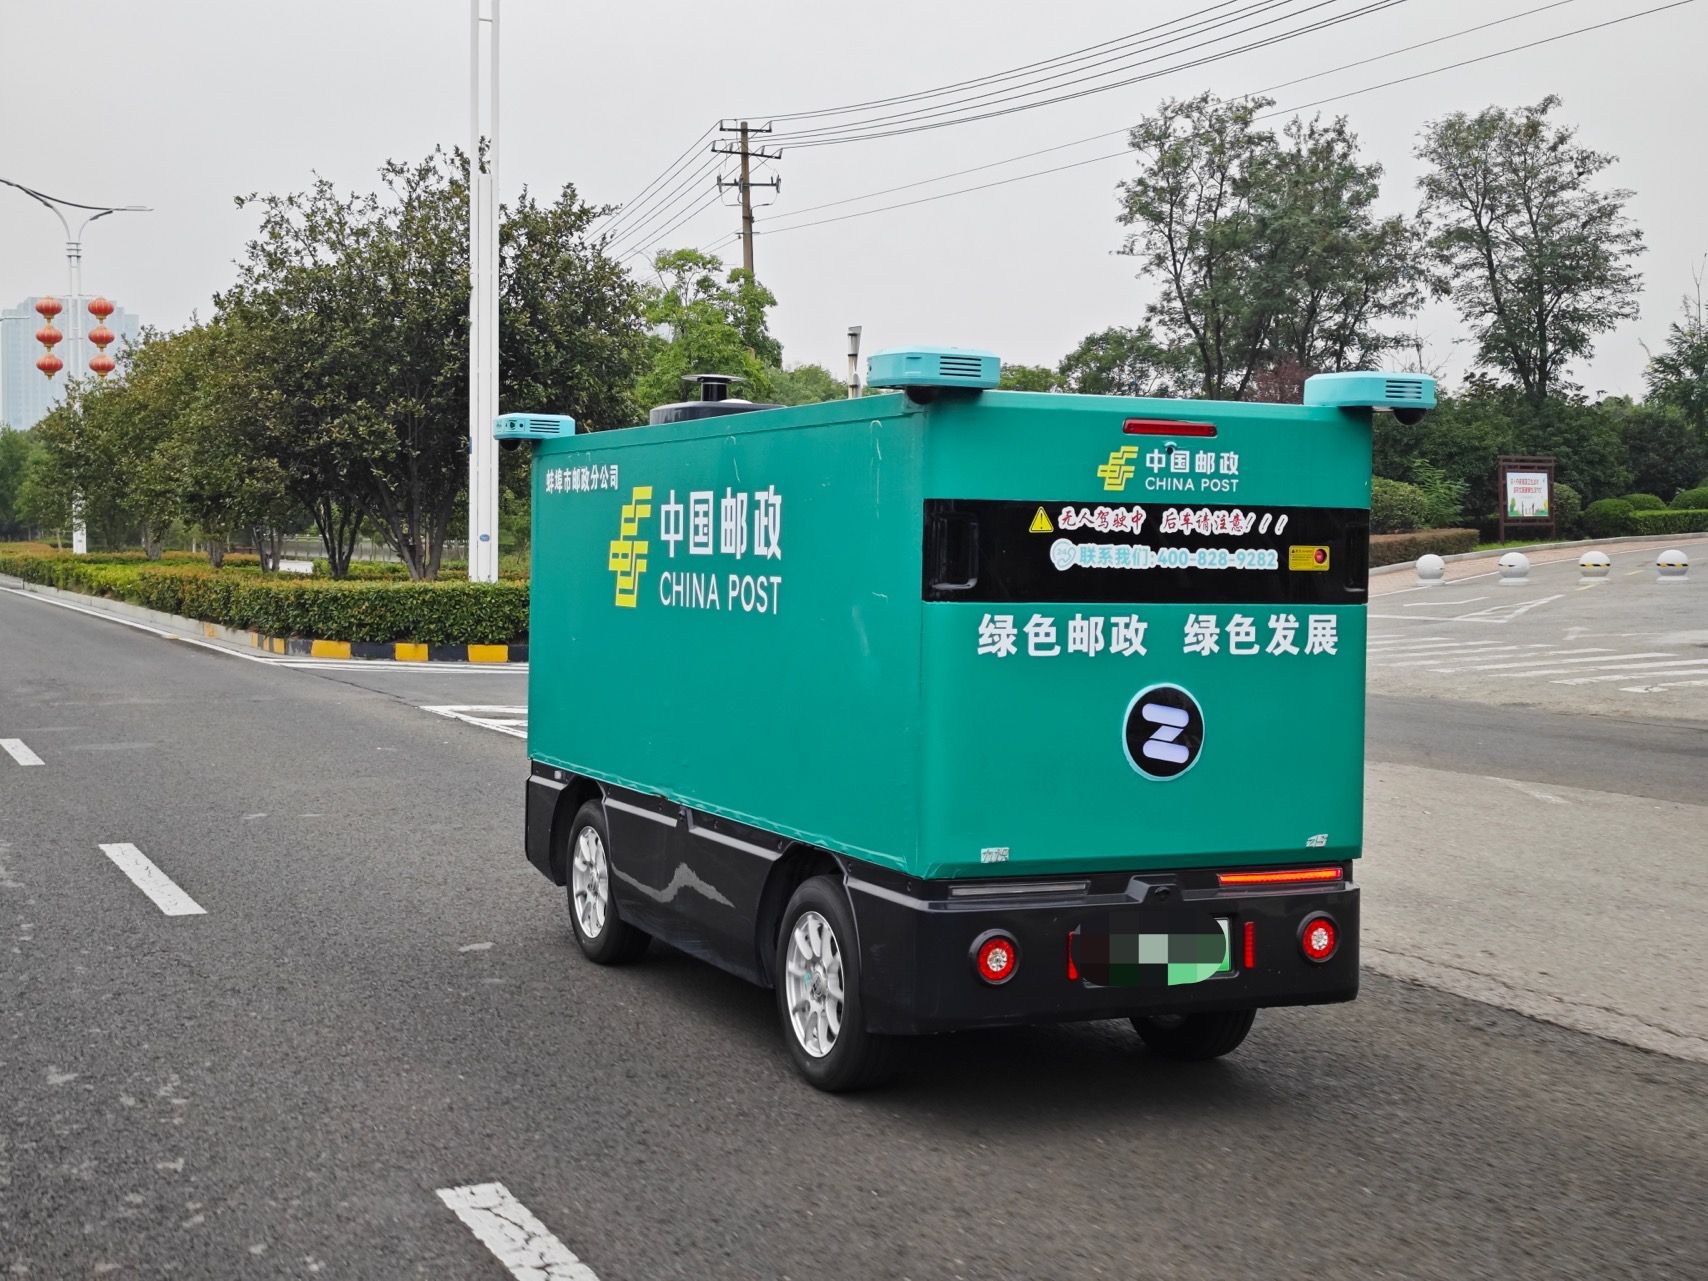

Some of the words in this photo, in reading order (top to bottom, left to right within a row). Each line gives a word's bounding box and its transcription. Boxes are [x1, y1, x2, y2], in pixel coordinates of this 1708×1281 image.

[1145, 448, 1239, 475] 中国邮政
[545, 464, 618, 494] 蚌埠市邮政分公司
[1145, 477, 1195, 491] CHINA
[1201, 479, 1239, 492] POST
[660, 484, 782, 560] 中国邮政
[1060, 507, 1145, 532] 无人驾驶中
[659, 571, 720, 610] CHINA
[728, 574, 782, 615] POST
[977, 613, 1148, 657] 绿色邮政
[1183, 613, 1338, 656] 绿色发展
